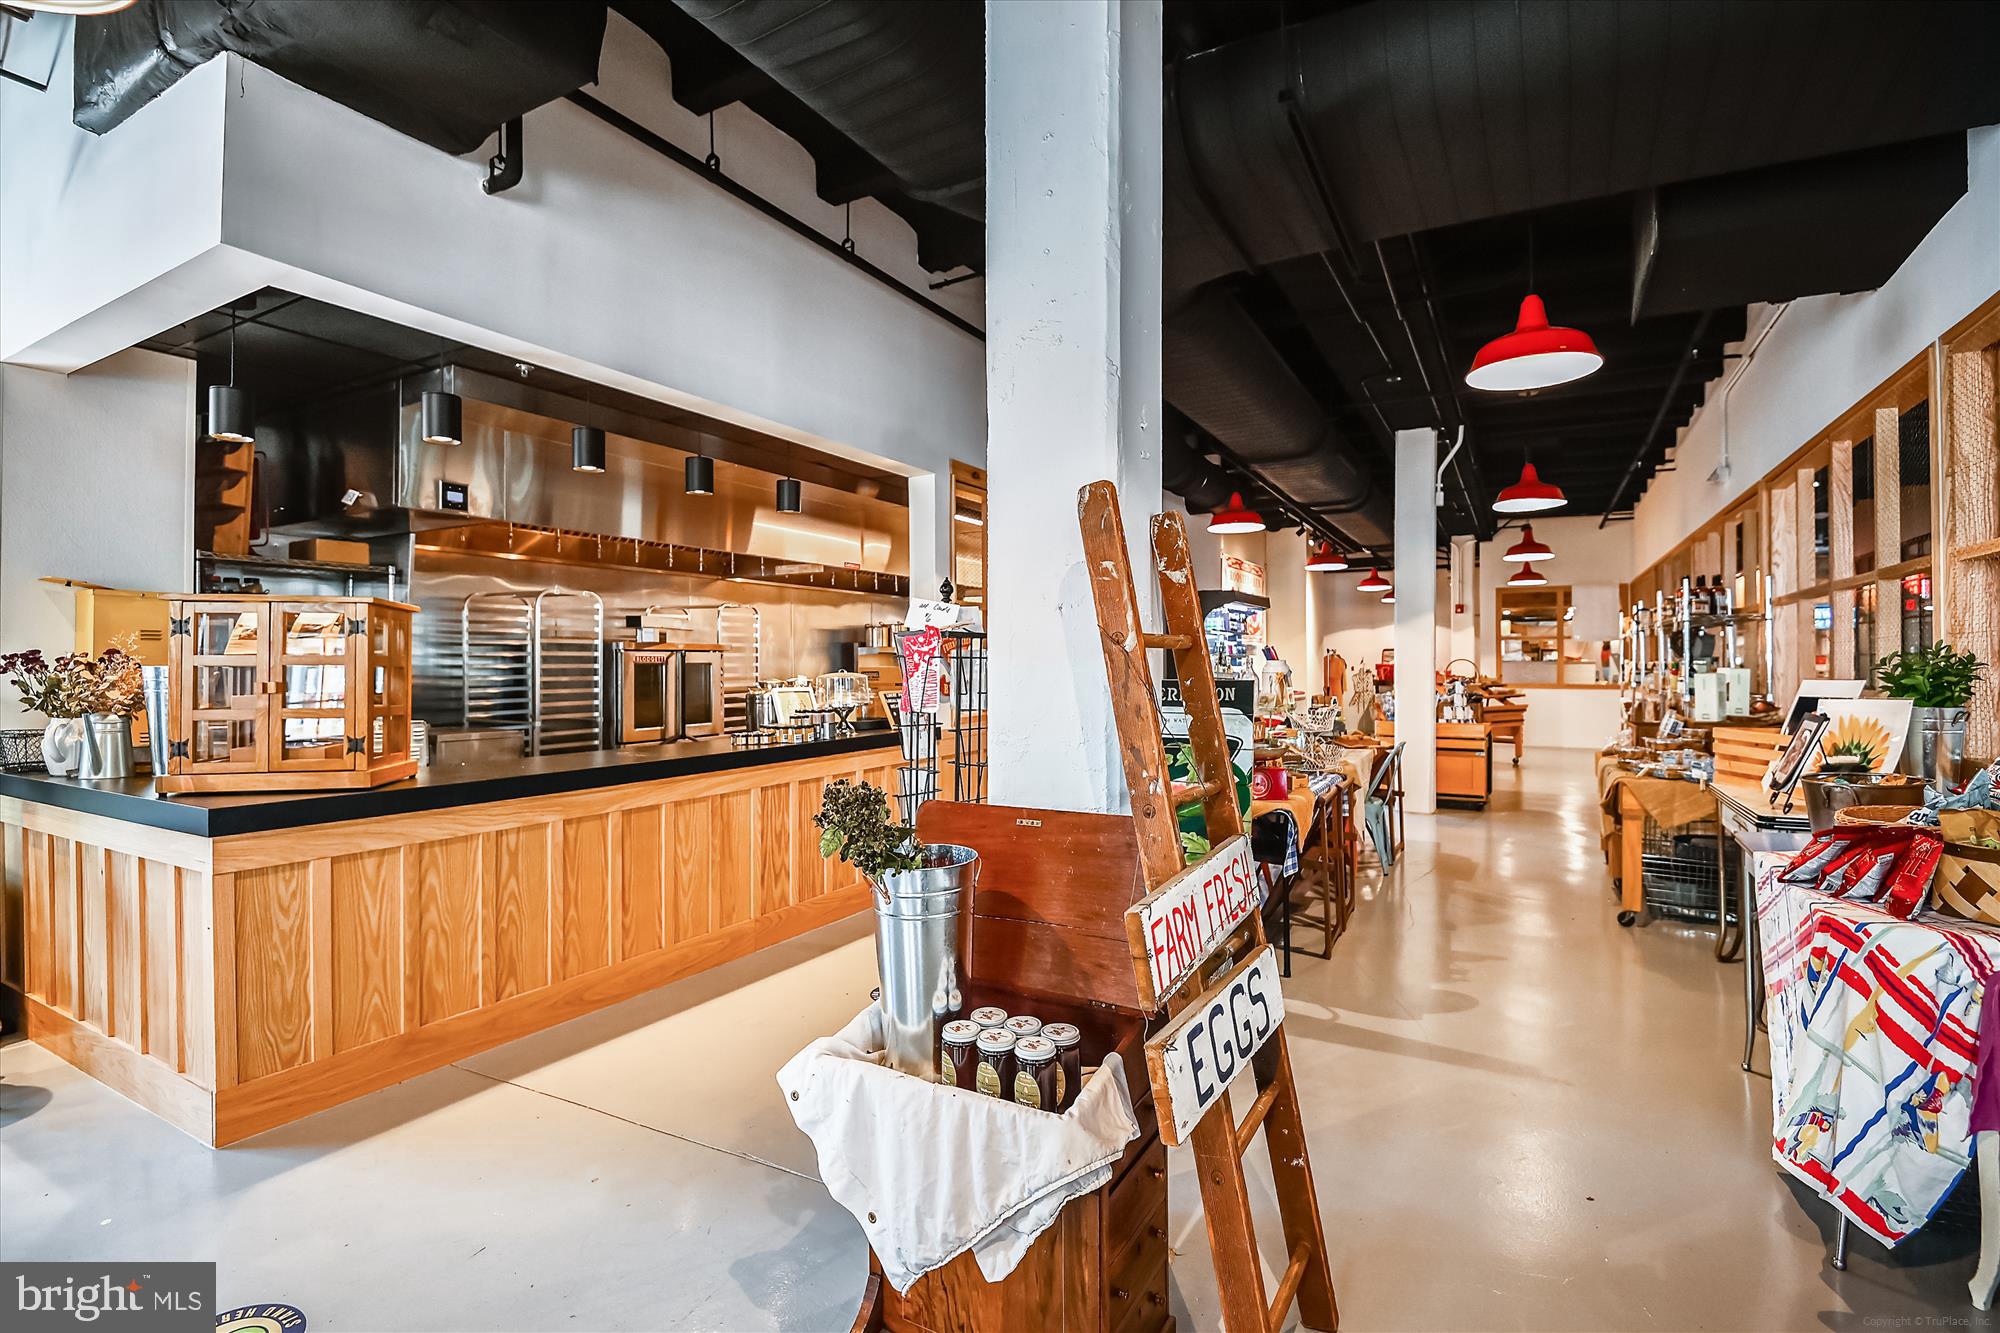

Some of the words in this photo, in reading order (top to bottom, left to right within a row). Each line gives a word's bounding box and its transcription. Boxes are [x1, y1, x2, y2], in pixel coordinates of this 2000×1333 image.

[1151, 895, 1203, 992] FARM
[1203, 851, 1254, 941] FRESH
[1187, 967, 1270, 1109] EGGS
[216, 1307, 257, 1325] HER
[262, 1306, 302, 1329] STAND
